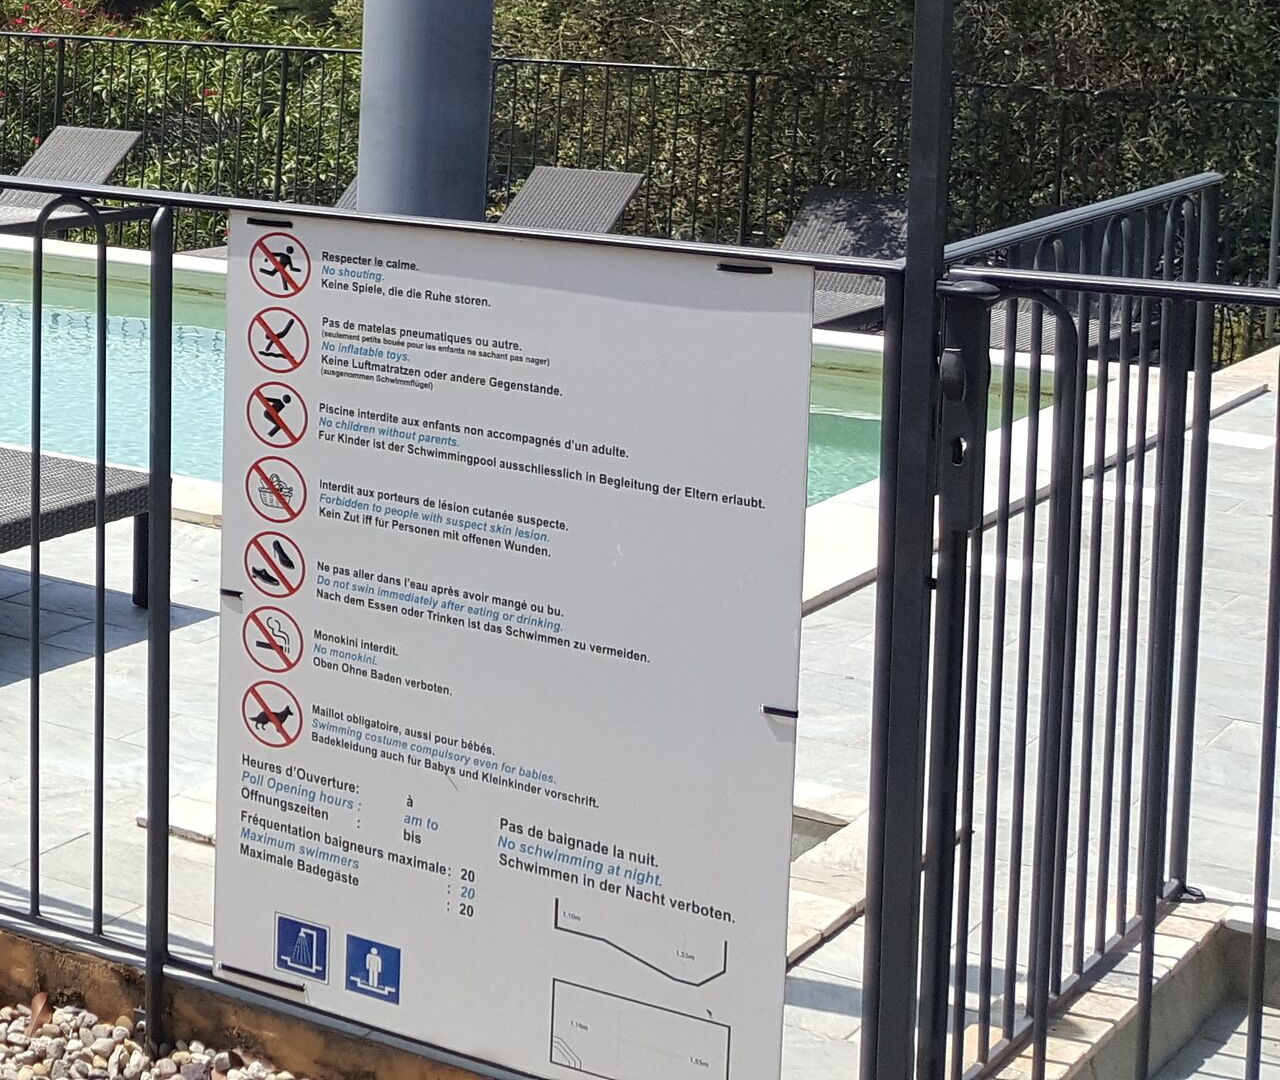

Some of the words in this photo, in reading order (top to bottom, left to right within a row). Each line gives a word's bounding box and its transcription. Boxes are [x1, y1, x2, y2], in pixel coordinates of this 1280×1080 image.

[321, 251, 373, 266] Respecter
[374, 256, 384, 268] le
[385, 259, 420, 272] calme.
[321, 265, 336, 276] No
[337, 268, 385, 284] shouting.
[321, 278, 350, 291] Keine
[351, 282, 386, 297] Spiele,
[388, 286, 404, 298] die
[406, 288, 422, 300] die
[424, 290, 452, 303] Ruhe
[321, 340, 336, 352] No
[337, 342, 384, 359] inflatable
[386, 350, 411, 363] toys.
[322, 316, 341, 329] Pas
[342, 320, 356, 331] de
[357, 323, 397, 336] matelas
[399, 328, 473, 346] pneumatiques
[475, 338, 489, 347] ou
[491, 340, 523, 352] autre.
[321, 354, 350, 368] Keine
[352, 358, 421, 378] Luftmatratzen
[423, 369, 448, 381] oder
[449, 373, 487, 386] andere
[318, 402, 355, 418] Piscine
[357, 408, 399, 424] interdite
[401, 417, 420, 428] aux
[422, 419, 461, 434] enfants
[463, 426, 484, 437] non
[486, 430, 562, 449] accompagnés
[564, 439, 589, 453] d'un
[591, 444, 629, 459] adulte.
[318, 416, 333, 428] No
[335, 420, 376, 435] children
[377, 426, 417, 441] without
[417, 434, 460, 448] parents.
[337, 432, 371, 448] Kinder
[372, 438, 386, 451] ist
[387, 441, 406, 453] der
[407, 444, 497, 468] Schwimmingpool
[499, 460, 583, 481] ausschliesslich
[585, 471, 596, 484] in
[599, 473, 660, 495] Begleitung
[662, 483, 682, 496] der
[684, 486, 719, 502] Eltern
[721, 494, 766, 510] erlaubt.
[319, 478, 355, 495] Interdit
[356, 488, 375, 499] aux
[377, 491, 420, 506] porteurs
[422, 497, 436, 509] de
[438, 498, 470, 515] lésion
[472, 507, 514, 522] cutanée
[517, 514, 569, 532] suspecte.
[319, 493, 370, 511] Forbidden
[372, 503, 383, 514] to
[383, 507, 420, 520] people
[421, 512, 443, 524] with
[445, 517, 488, 532] suspect
[489, 523, 512, 536] skin
[514, 526, 550, 543] lesion.
[319, 506, 341, 520] Kein
[391, 519, 440, 538] Personen
[442, 530, 460, 542] mit
[461, 532, 502, 549] offenen
[504, 538, 552, 558] Wunden.
[316, 574, 331, 587] Do
[332, 580, 350, 591] not
[377, 586, 439, 610] immediately
[440, 600, 466, 613] after
[467, 606, 500, 622] eating
[502, 613, 515, 622] or
[516, 610, 564, 634] drinking.
[317, 560, 331, 573] Ne
[332, 566, 351, 577] pas
[352, 568, 375, 582] aller
[376, 572, 402, 587] dans
[404, 577, 429, 592] l'eau
[431, 585, 460, 598] après
[462, 590, 490, 603] avoir
[491, 596, 528, 612] mangé
[530, 604, 544, 614] ou
[547, 604, 564, 618] bu.
[313, 629, 358, 649] Monokini
[360, 639, 399, 657] interdit.
[316, 588, 342, 603] Nach
[343, 594, 365, 608] dem
[367, 598, 399, 614] Essen
[400, 606, 425, 619] oder
[428, 610, 465, 628] Trinken
[467, 617, 481, 631] ist
[483, 621, 503, 635] das
[505, 625, 571, 648] Schwimmen
[573, 640, 587, 651] zu
[589, 643, 651, 663] vermeiden.
[313, 643, 328, 655] No
[329, 648, 378, 666] monokini.
[313, 656, 339, 672] Oben
[341, 662, 368, 678] Ohne
[370, 668, 402, 686] Baden
[404, 678, 453, 697] verboten.
[311, 718, 363, 741] Swimming
[364, 728, 408, 750] costume
[410, 743, 471, 766] compulsory
[473, 758, 499, 771] even
[500, 762, 517, 775] for
[518, 766, 557, 785] babies.
[312, 704, 344, 722] Maillot
[346, 713, 402, 737] obligatoire,
[404, 728, 432, 742] aussi
[434, 734, 459, 748] pour
[461, 738, 496, 757] bébés.
[242, 753, 282, 775] Heures
[311, 731, 378, 759] Badekleidung
[380, 750, 405, 763] auch
[424, 758, 456, 776] Babys
[459, 768, 479, 781] und
[481, 771, 542, 795] Kleinkinder
[544, 788, 600, 809] vorschrift.
[267, 777, 317, 803] Opening
[319, 790, 354, 810] hours
[403, 814, 423, 828] am
[426, 818, 439, 830] to
[240, 810, 321, 843] Fréquentation
[324, 832, 384, 859] baigneurs
[460, 868, 476, 883] 20
[403, 828, 422, 845] bis
[497, 835, 516, 851] No
[519, 843, 604, 875] schwimming
[607, 865, 621, 877] at
[623, 868, 663, 887] night.
[499, 817, 524, 835] Pas
[527, 825, 544, 840] de
[547, 828, 609, 856] baignade
[613, 844, 625, 860] la
[628, 851, 659, 868] nuit.
[240, 826, 296, 853] Maximum
[298, 845, 360, 870] swimmers
[460, 886, 476, 900] 20
[240, 842, 294, 869] Maximale
[459, 902, 475, 917] 20
[498, 852, 579, 885] Schwimmen
[583, 873, 595, 889] in
[599, 878, 622, 895] der
[625, 884, 666, 907] Nacht
[669, 898, 736, 924] verboten.
